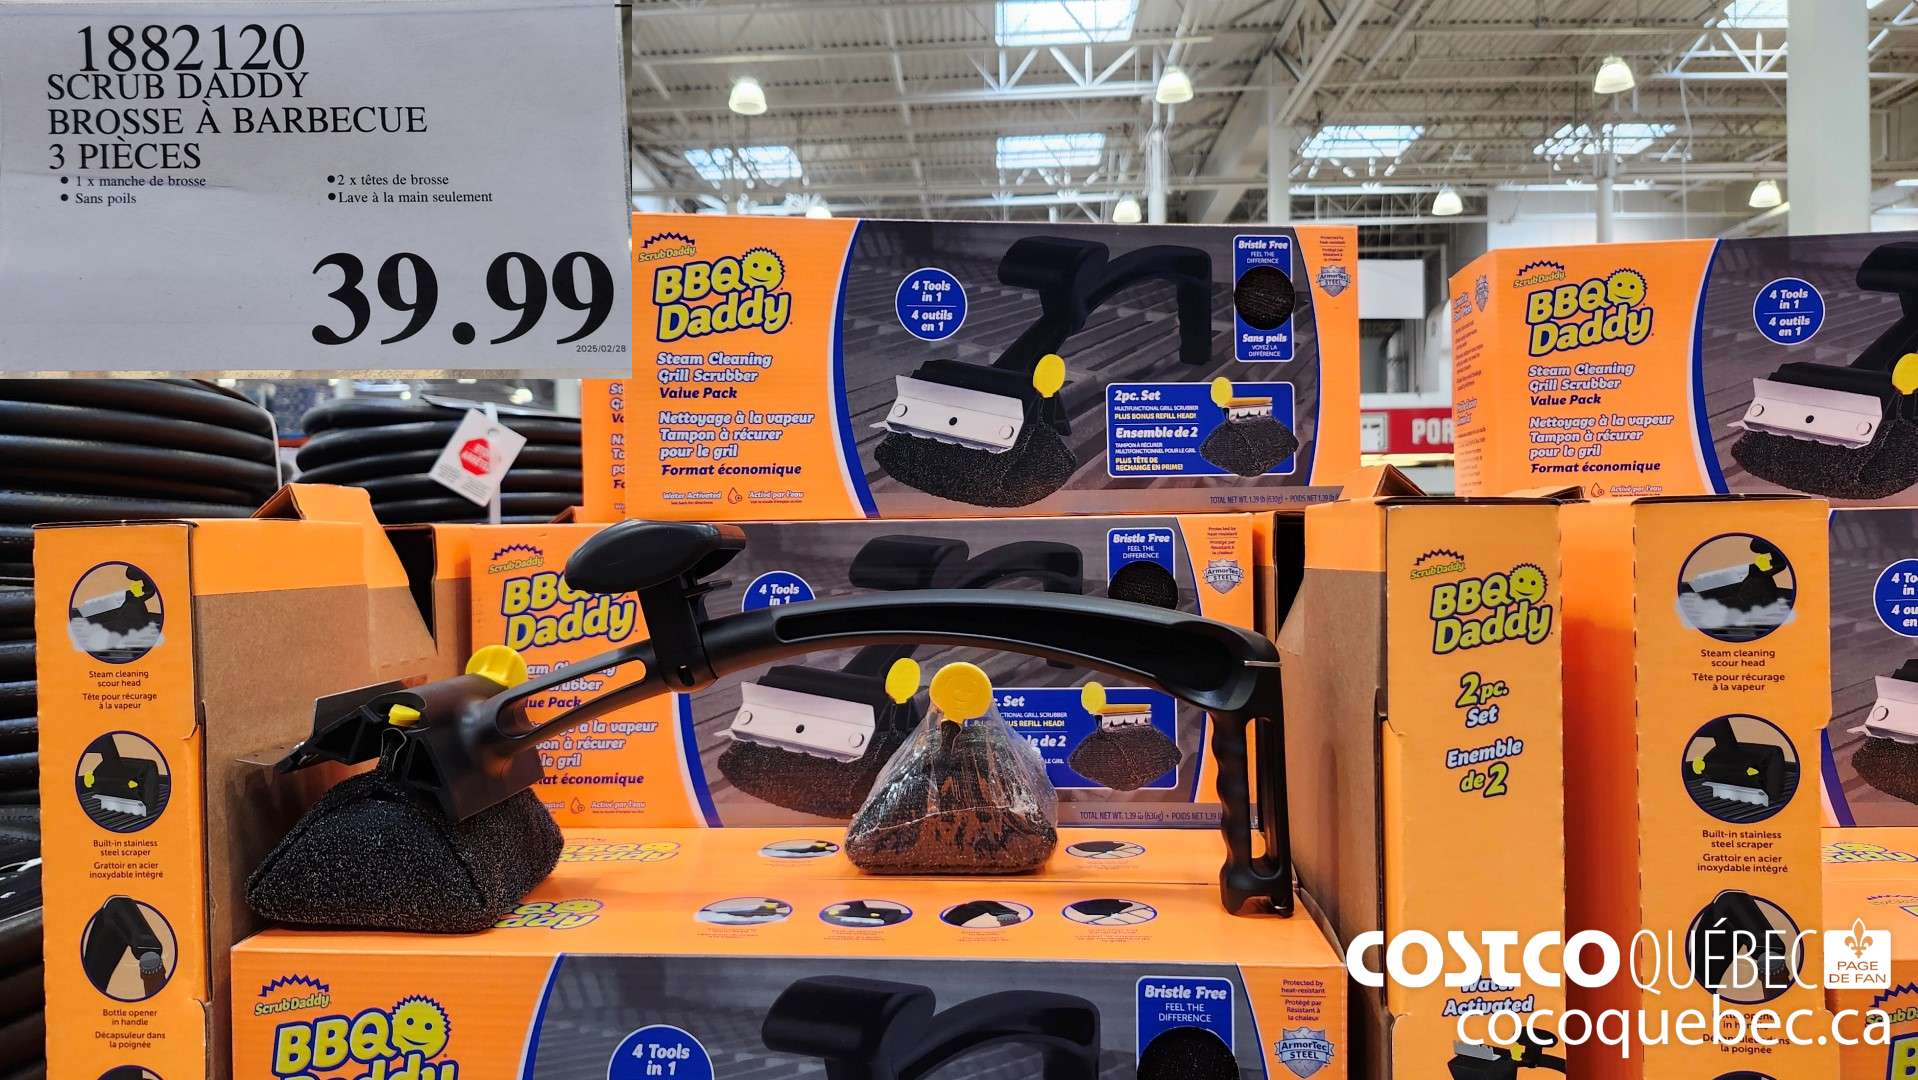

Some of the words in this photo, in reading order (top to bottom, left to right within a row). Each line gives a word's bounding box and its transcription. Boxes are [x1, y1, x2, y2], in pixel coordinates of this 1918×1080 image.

[77, 23, 305, 72] 1882120
[47, 74, 165, 100] SCRUB
[178, 72, 310, 99] DADDY
[48, 107, 183, 135] BROSSE
[197, 101, 222, 133] À
[234, 105, 428, 133] BARBECUE
[49, 143, 65, 169] 3
[79, 136, 202, 169] PIÈCES
[76, 175, 81, 187] 1
[87, 178, 95, 187] x
[98, 175, 147, 188] manche
[150, 175, 164, 188] de
[167, 175, 207, 188] brosse
[337, 174, 346, 185] 2
[350, 176, 358, 185] x
[361, 173, 389, 186] têtes
[393, 173, 407, 186] de
[410, 173, 450, 186] brosse
[75, 191, 102, 205] Sans
[105, 191, 137, 207] poils
[339, 190, 368, 204] Lave
[371, 190, 380, 204] à
[383, 190, 394, 204] la
[398, 190, 429, 204] main
[432, 189, 493, 203] seulement
[1238, 240, 1266, 250] Bristle
[1268, 240, 1288, 250] Free
[1246, 257, 1279, 265] DIFFERENCE
[653, 258, 745, 305] BBQ
[912, 280, 920, 292] 4
[923, 280, 951, 292] Tools
[311, 251, 614, 346] 39.99
[921, 292, 933, 303] in
[936, 292, 943, 302] 1
[1526, 278, 1609, 325] BBQ
[656, 288, 792, 343] Daddy
[912, 309, 920, 321] 4
[922, 309, 953, 321] outils
[921, 322, 934, 333] en
[937, 321, 944, 332] 1
[1529, 303, 1653, 357] Daddy
[1242, 333, 1264, 344] Sans
[1266, 333, 1288, 346] poils
[576, 344, 627, 354] 2025/02/28
[657, 352, 703, 367] Steam
[707, 353, 773, 369] Cleaning
[657, 368, 690, 385] Grill
[693, 369, 758, 384] Scrubber
[1528, 364, 1571, 378] Steam
[1575, 362, 1635, 378] Cleaning
[1528, 377, 1557, 393] Grill
[1561, 376, 1621, 392] Scrubber
[660, 386, 700, 400] Value
[703, 386, 737, 400] Pack
[1141, 390, 1161, 401] Set
[1530, 393, 1566, 407] Value
[1569, 393, 1601, 405] Pack
[658, 411, 732, 428] Nettoyage
[736, 410, 746, 425] à
[748, 411, 762, 425] la
[766, 412, 815, 427] vapeur
[659, 427, 716, 442] Tampon
[720, 427, 730, 441] à
[733, 427, 783, 441] récurer
[1115, 426, 1173, 438] Ensemble
[1174, 426, 1190, 438] de
[1190, 426, 1199, 438] 2
[660, 446, 693, 461] pour
[697, 445, 710, 459] le
[714, 444, 738, 461] gril
[662, 464, 716, 476] Format
[719, 463, 802, 478] économique
[1531, 462, 1579, 474] Format
[1582, 460, 1661, 474] économique
[1430, 572, 1512, 620] BBQ
[505, 593, 636, 652] Daddy
[1433, 600, 1552, 654] Daddy
[1701, 649, 1731, 658] Steam
[1733, 649, 1775, 659] cleaning
[1711, 659, 1738, 667] scour
[1741, 658, 1766, 667] head
[88, 670, 114, 679] Steam
[115, 670, 149, 679] cleaning
[97, 680, 120, 688] scour
[121, 679, 141, 687] head
[83, 692, 100, 701] Tête
[102, 694, 120, 702] pour
[122, 692, 157, 702] récurage
[1003, 695, 1025, 707] Set
[98, 701, 104, 709] à
[105, 701, 113, 709] la
[114, 703, 141, 711] vapeur
[1466, 704, 1499, 728] Set
[610, 721, 658, 736] vapeur
[577, 736, 625, 750] récurer
[1446, 736, 1523, 769] Enemble
[561, 773, 644, 787] économique
[1460, 769, 1486, 792] de
[1483, 761, 1509, 798] 2
[93, 840, 122, 848] Built-in
[124, 840, 158, 848] stainless
[122, 849, 151, 858] scraper
[93, 862, 125, 870] Grattoir
[139, 862, 159, 870] acier
[89, 871, 133, 880] inoxydable
[1281, 986, 1325, 994] heat-resistant
[1283, 979, 1315, 987] Protected
[1316, 980, 1324, 988] by
[1145, 984, 1191, 999] Bristle
[1195, 986, 1227, 1000] Free
[103, 1009, 126, 1017] Bottle
[128, 1010, 157, 1018] opener
[1165, 1003, 1185, 1011] FEEL
[1188, 1003, 1205, 1012] THE
[112, 1018, 119, 1026] in
[120, 1018, 148, 1026] handle
[1158, 1013, 1212, 1023] DIFFERENCE
[95, 1031, 145, 1040] Décapsuleur
[147, 1031, 166, 1039] dans
[272, 1008, 400, 1075] BBQ
[119, 1041, 151, 1050] poignée
[632, 1043, 644, 1059] 4
[649, 1043, 690, 1059] Tools
[1281, 1041, 1328, 1052] ArmorTec
[1290, 1051, 1320, 1059] STEEL
[646, 1060, 662, 1075] in
[668, 1060, 677, 1075] 1
